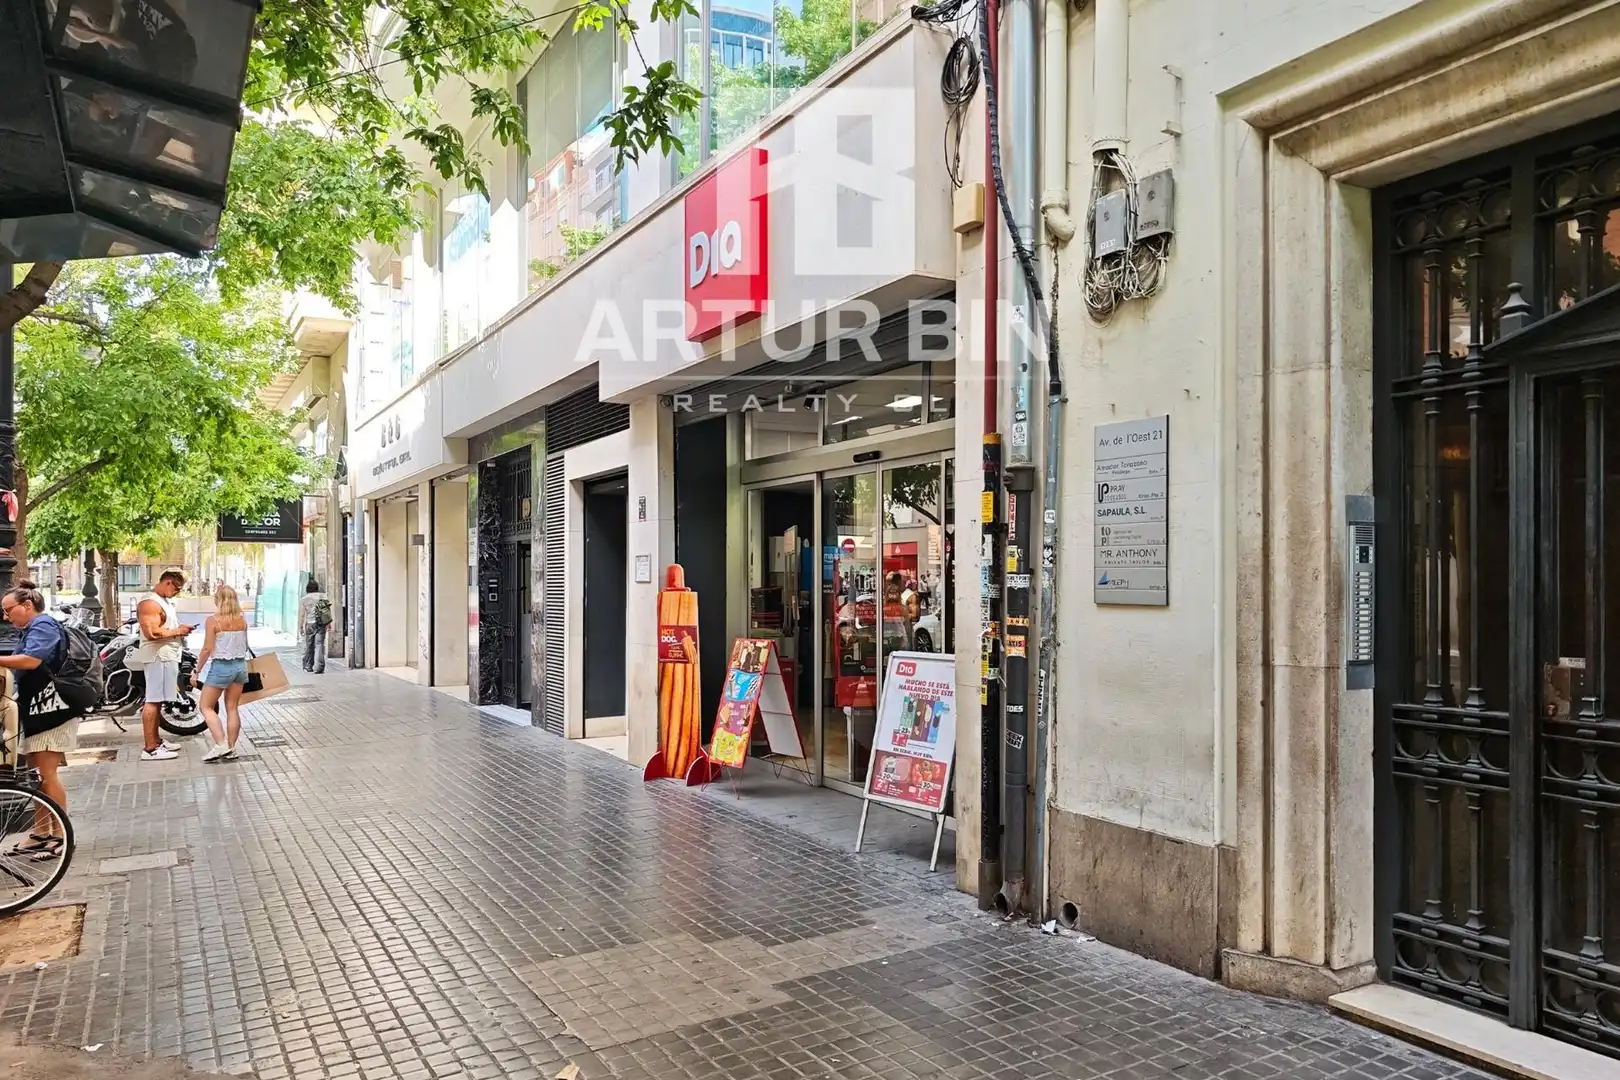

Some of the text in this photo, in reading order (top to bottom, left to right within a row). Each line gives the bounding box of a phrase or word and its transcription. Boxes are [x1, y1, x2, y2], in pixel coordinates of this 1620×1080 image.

[1099, 438, 1111, 447] Av.
[1113, 436, 1123, 446] de
[1152, 429, 1163, 441] 21
[1097, 505, 1148, 518] SAPAULA, S.L.
[1100, 548, 1158, 558] MR. ANTHONY
[905, 679, 927, 687] MUCHO
[898, 684, 931, 694] HABLANDO
[908, 692, 929, 700] NUEVO
